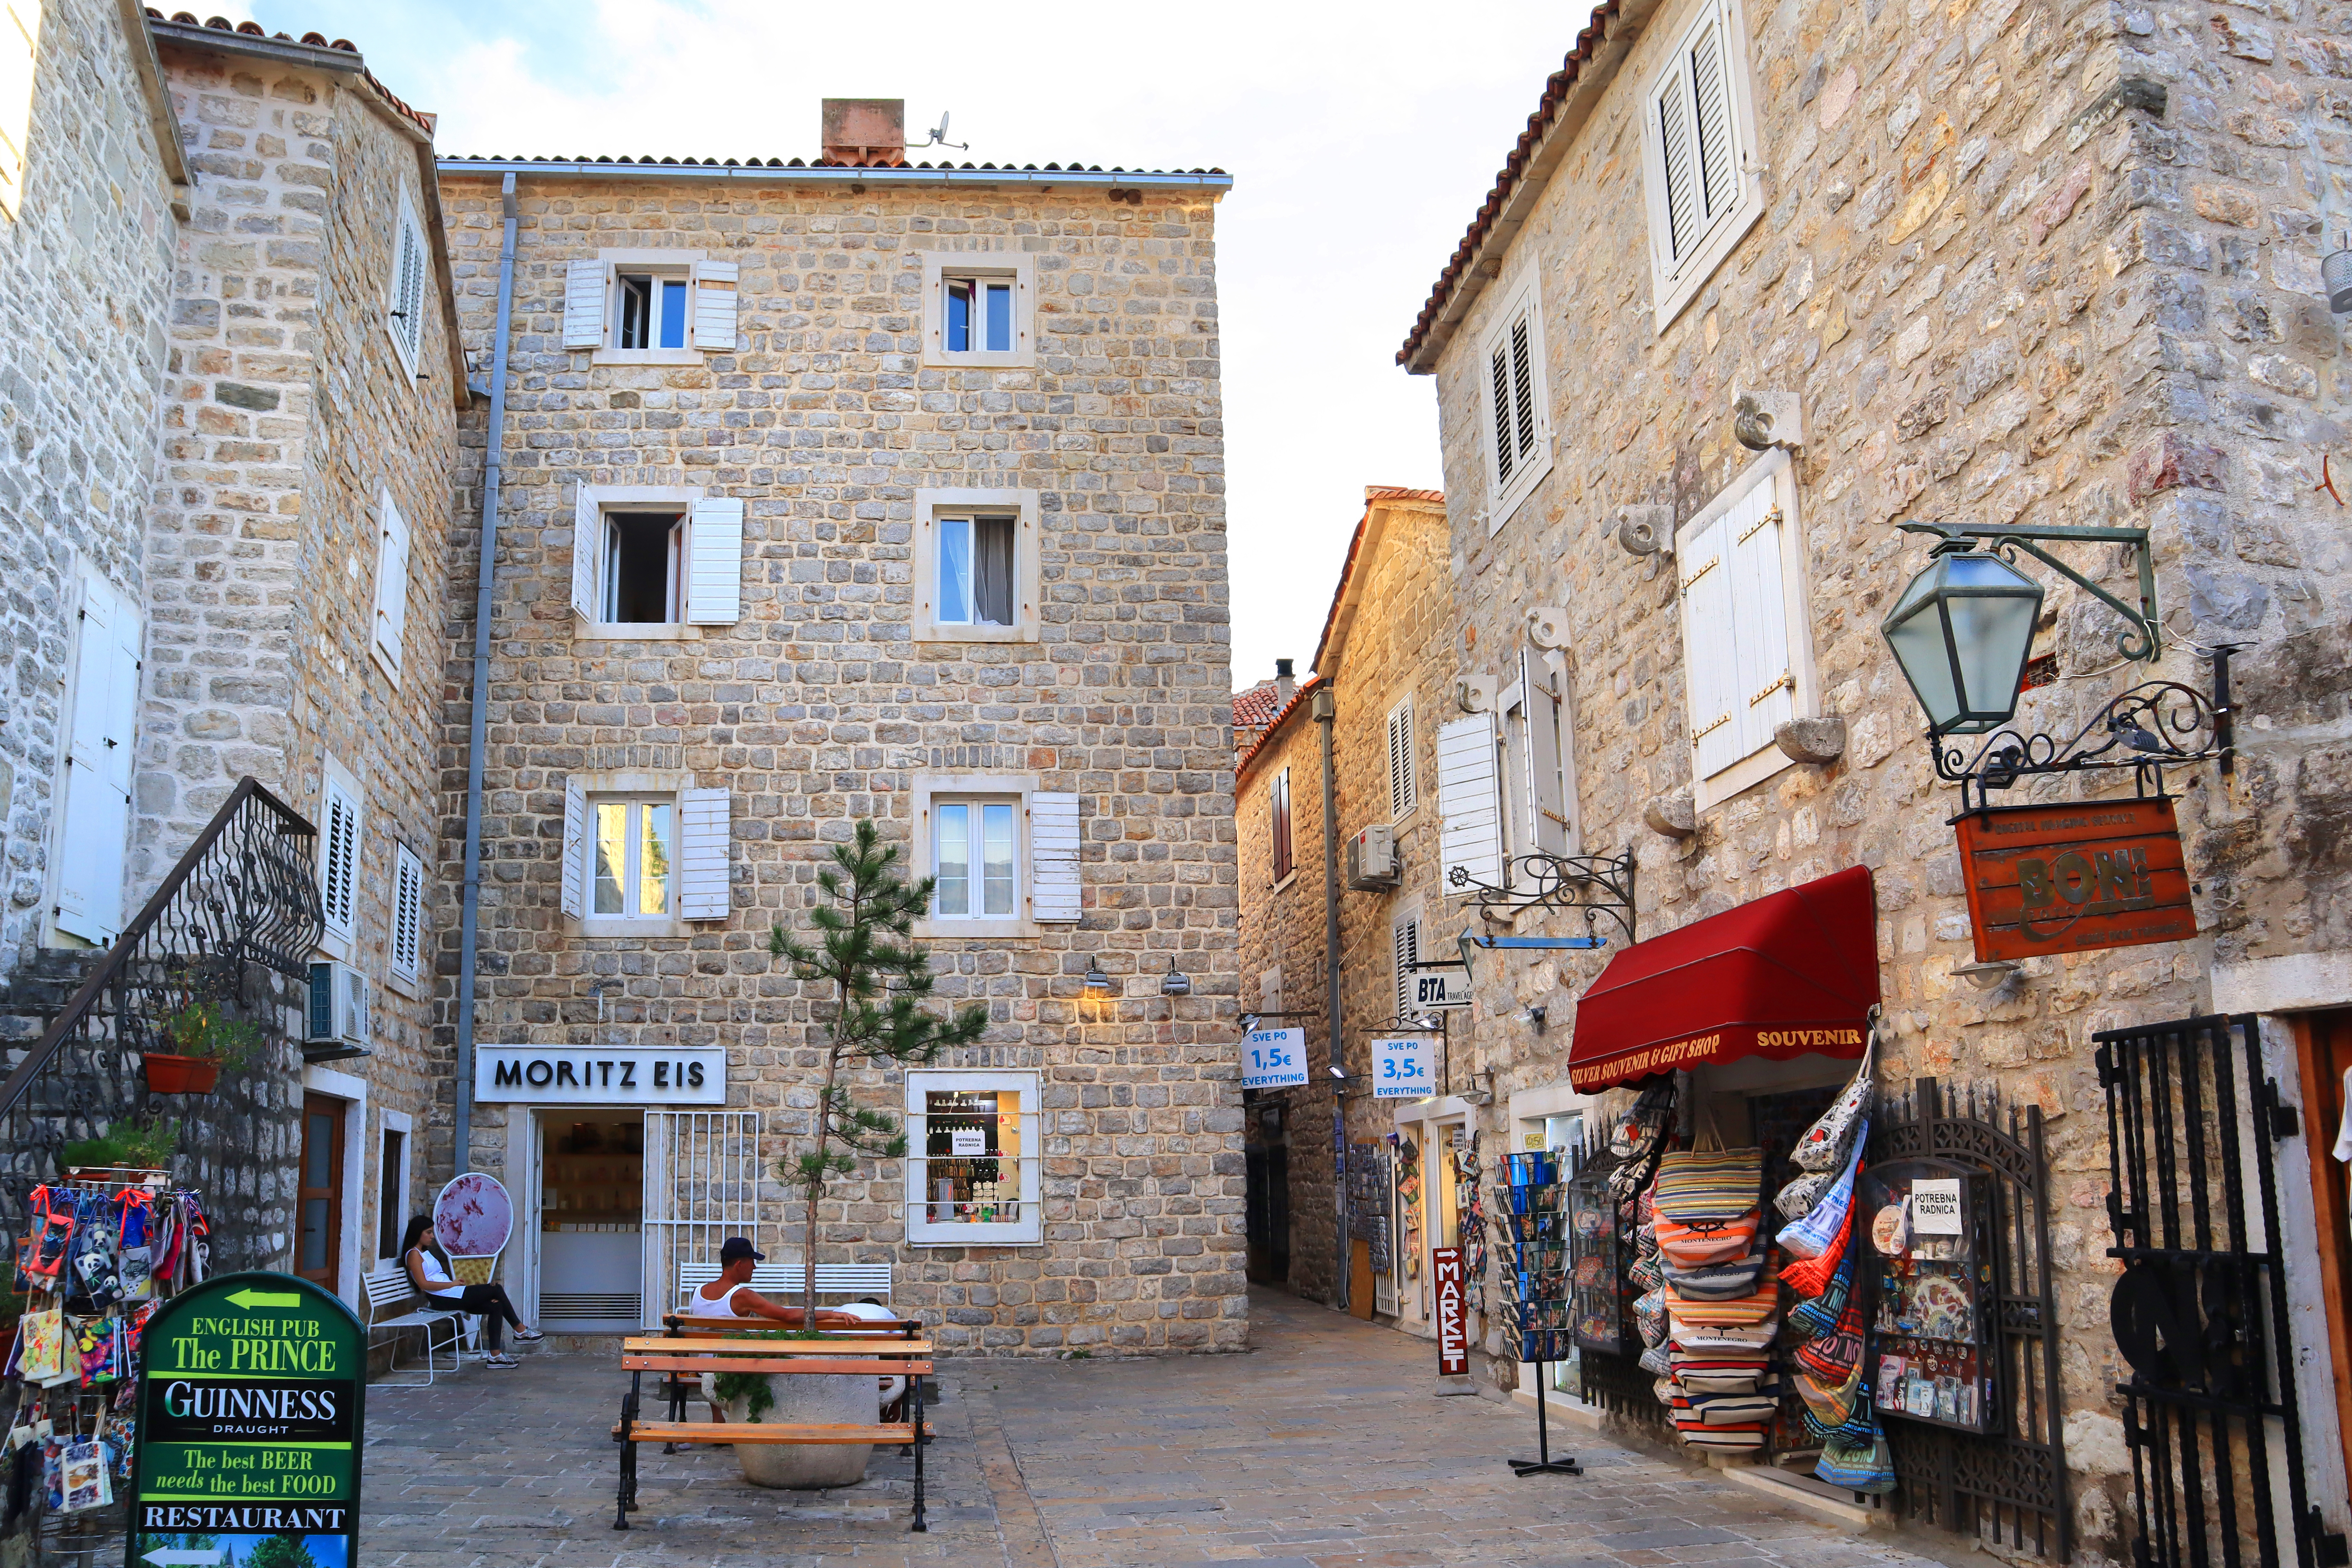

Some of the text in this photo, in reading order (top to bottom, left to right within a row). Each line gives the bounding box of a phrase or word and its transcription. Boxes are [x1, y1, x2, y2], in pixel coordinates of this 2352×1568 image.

[1418, 978, 1446, 1002] BTA
[1447, 992, 1463, 1000] TRAVEL
[1252, 1032, 1287, 1042] SVE PO
[1757, 1029, 1862, 1046] SOUVENIR
[1251, 1048, 1292, 1071] 1,5€
[1383, 1058, 1424, 1080] 3,5€
[1572, 1034, 1720, 1085] SILVER SOUVENIR & GIFT SHOP
[495, 1060, 704, 1087] MORITZ EIS
[1242, 1073, 1305, 1086] EVERYTHING
[1377, 1087, 1432, 1095] EVERYTHING
[1915, 1194, 1957, 1203] POTREBNA
[1920, 1205, 1955, 1214] RADNICA
[1437, 1261, 1464, 1371] MARKET
[191, 1318, 319, 1337] ENGLISH PUB
[172, 1337, 336, 1372] The PRINCE
[165, 1381, 335, 1420] GUINNESS
[213, 1425, 289, 1434] DRAUGHT
[184, 1450, 313, 1470] The best BEER
[156, 1470, 336, 1494] needs the best FOOD
[144, 1506, 345, 1529] RESTAURANT
